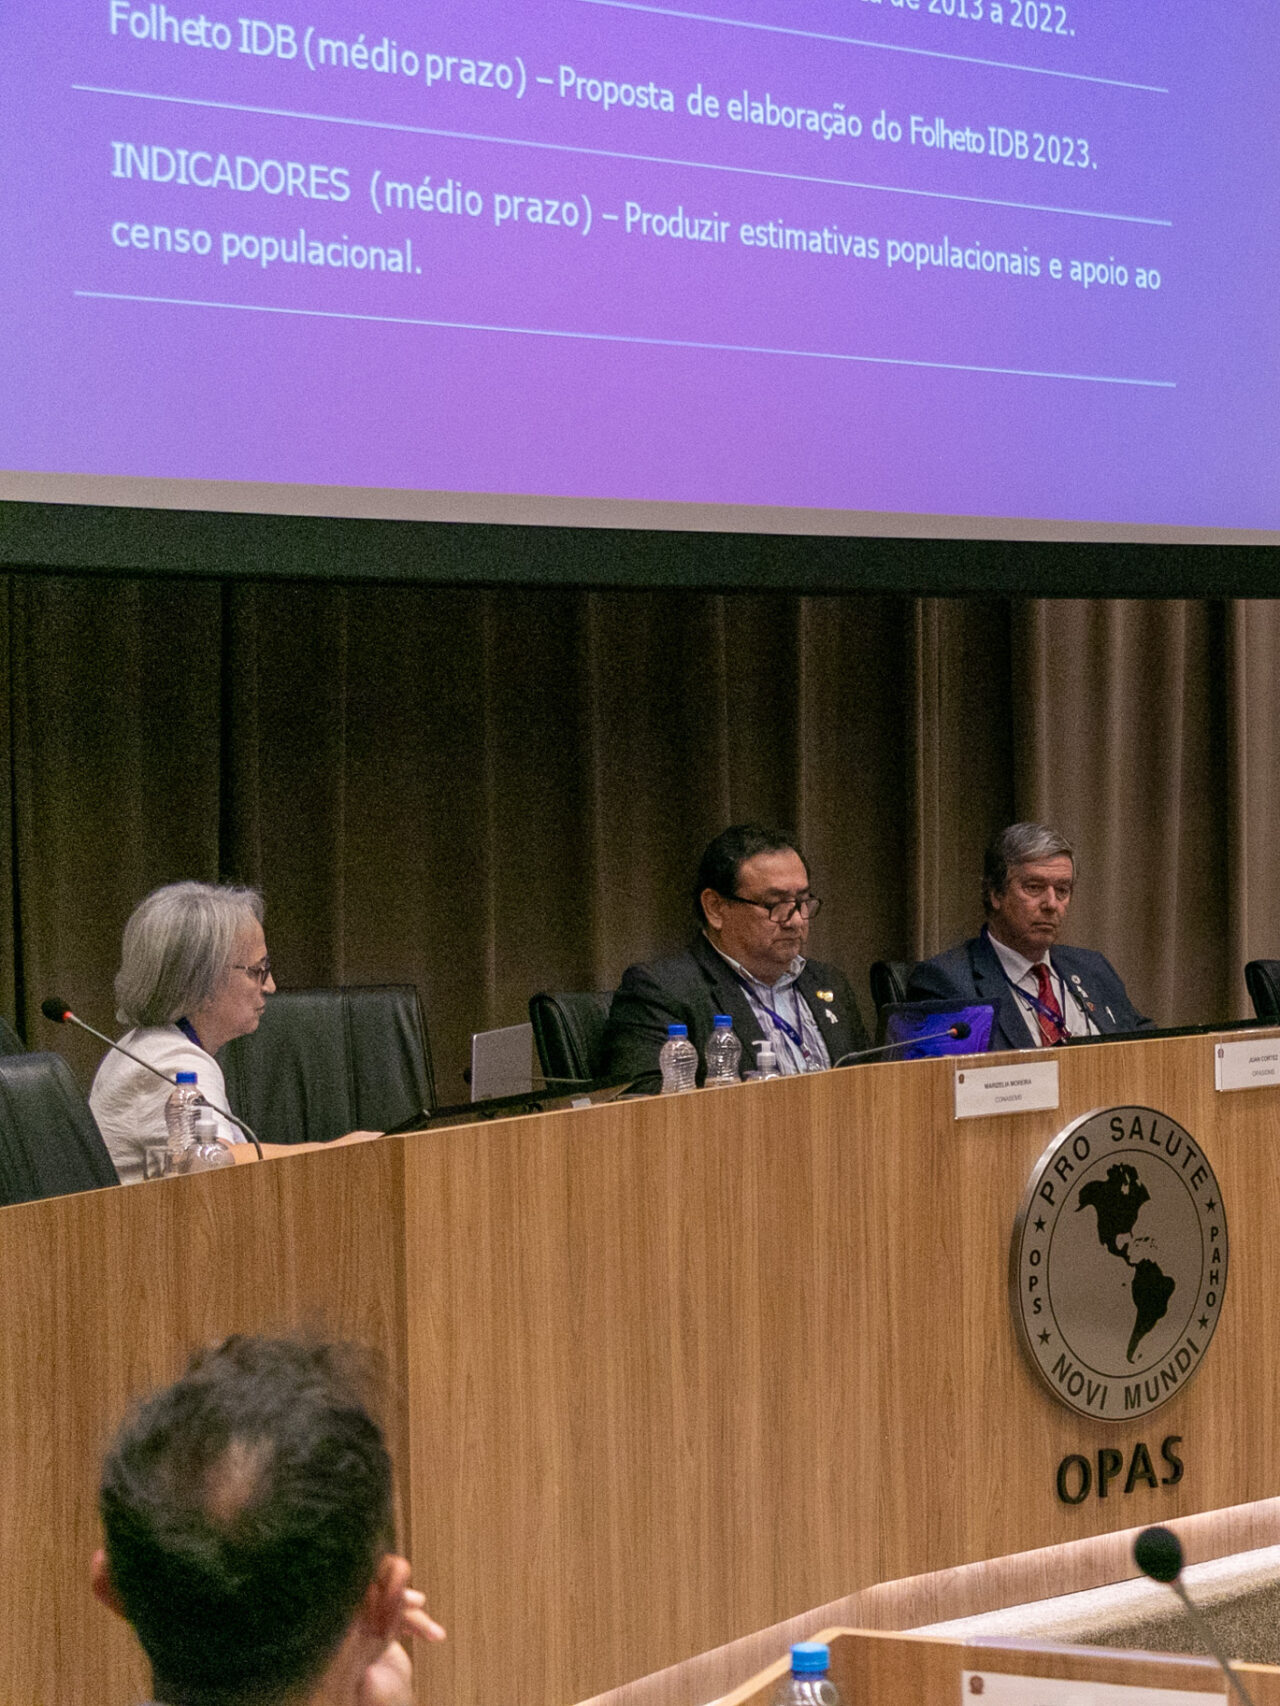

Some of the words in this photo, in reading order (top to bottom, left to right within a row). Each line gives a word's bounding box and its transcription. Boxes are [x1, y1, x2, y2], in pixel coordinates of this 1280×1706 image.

[928, 0, 984, 21] 2013
[989, 2, 1004, 25] a
[1010, 0, 1076, 36] 2022.
[110, 0, 232, 51] Folheto
[238, 18, 298, 60] IDB
[303, 26, 419, 77] (médio
[425, 53, 527, 100] prazo)
[558, 65, 675, 113] Proposta
[686, 83, 720, 119] de
[726, 93, 863, 141] elaboração
[870, 108, 903, 143] do
[909, 115, 986, 154] Folheto
[987, 126, 1030, 160] IDB
[1032, 132, 1098, 170] 2023.
[110, 141, 352, 204] INDICADORES
[370, 170, 484, 217] (médio
[493, 193, 593, 237] prazo)
[624, 201, 731, 244] Produzir
[738, 219, 881, 259] estimativas
[886, 236, 1042, 279] populacionais
[1048, 257, 1063, 280] e
[1069, 256, 1130, 290] apoio
[1134, 267, 1162, 291] ao
[110, 221, 213, 255] censo
[221, 230, 423, 275] populacional.
[1038, 1136, 1091, 1207] PRO
[1110, 1115, 1209, 1192] SALUTE
[1028, 1248, 1043, 1315] OPS
[1208, 1225, 1222, 1308] PAHO
[1051, 1353, 1108, 1410] NOVI
[1124, 1337, 1200, 1411] MUNDI
[1056, 1435, 1184, 1506] OPAS
